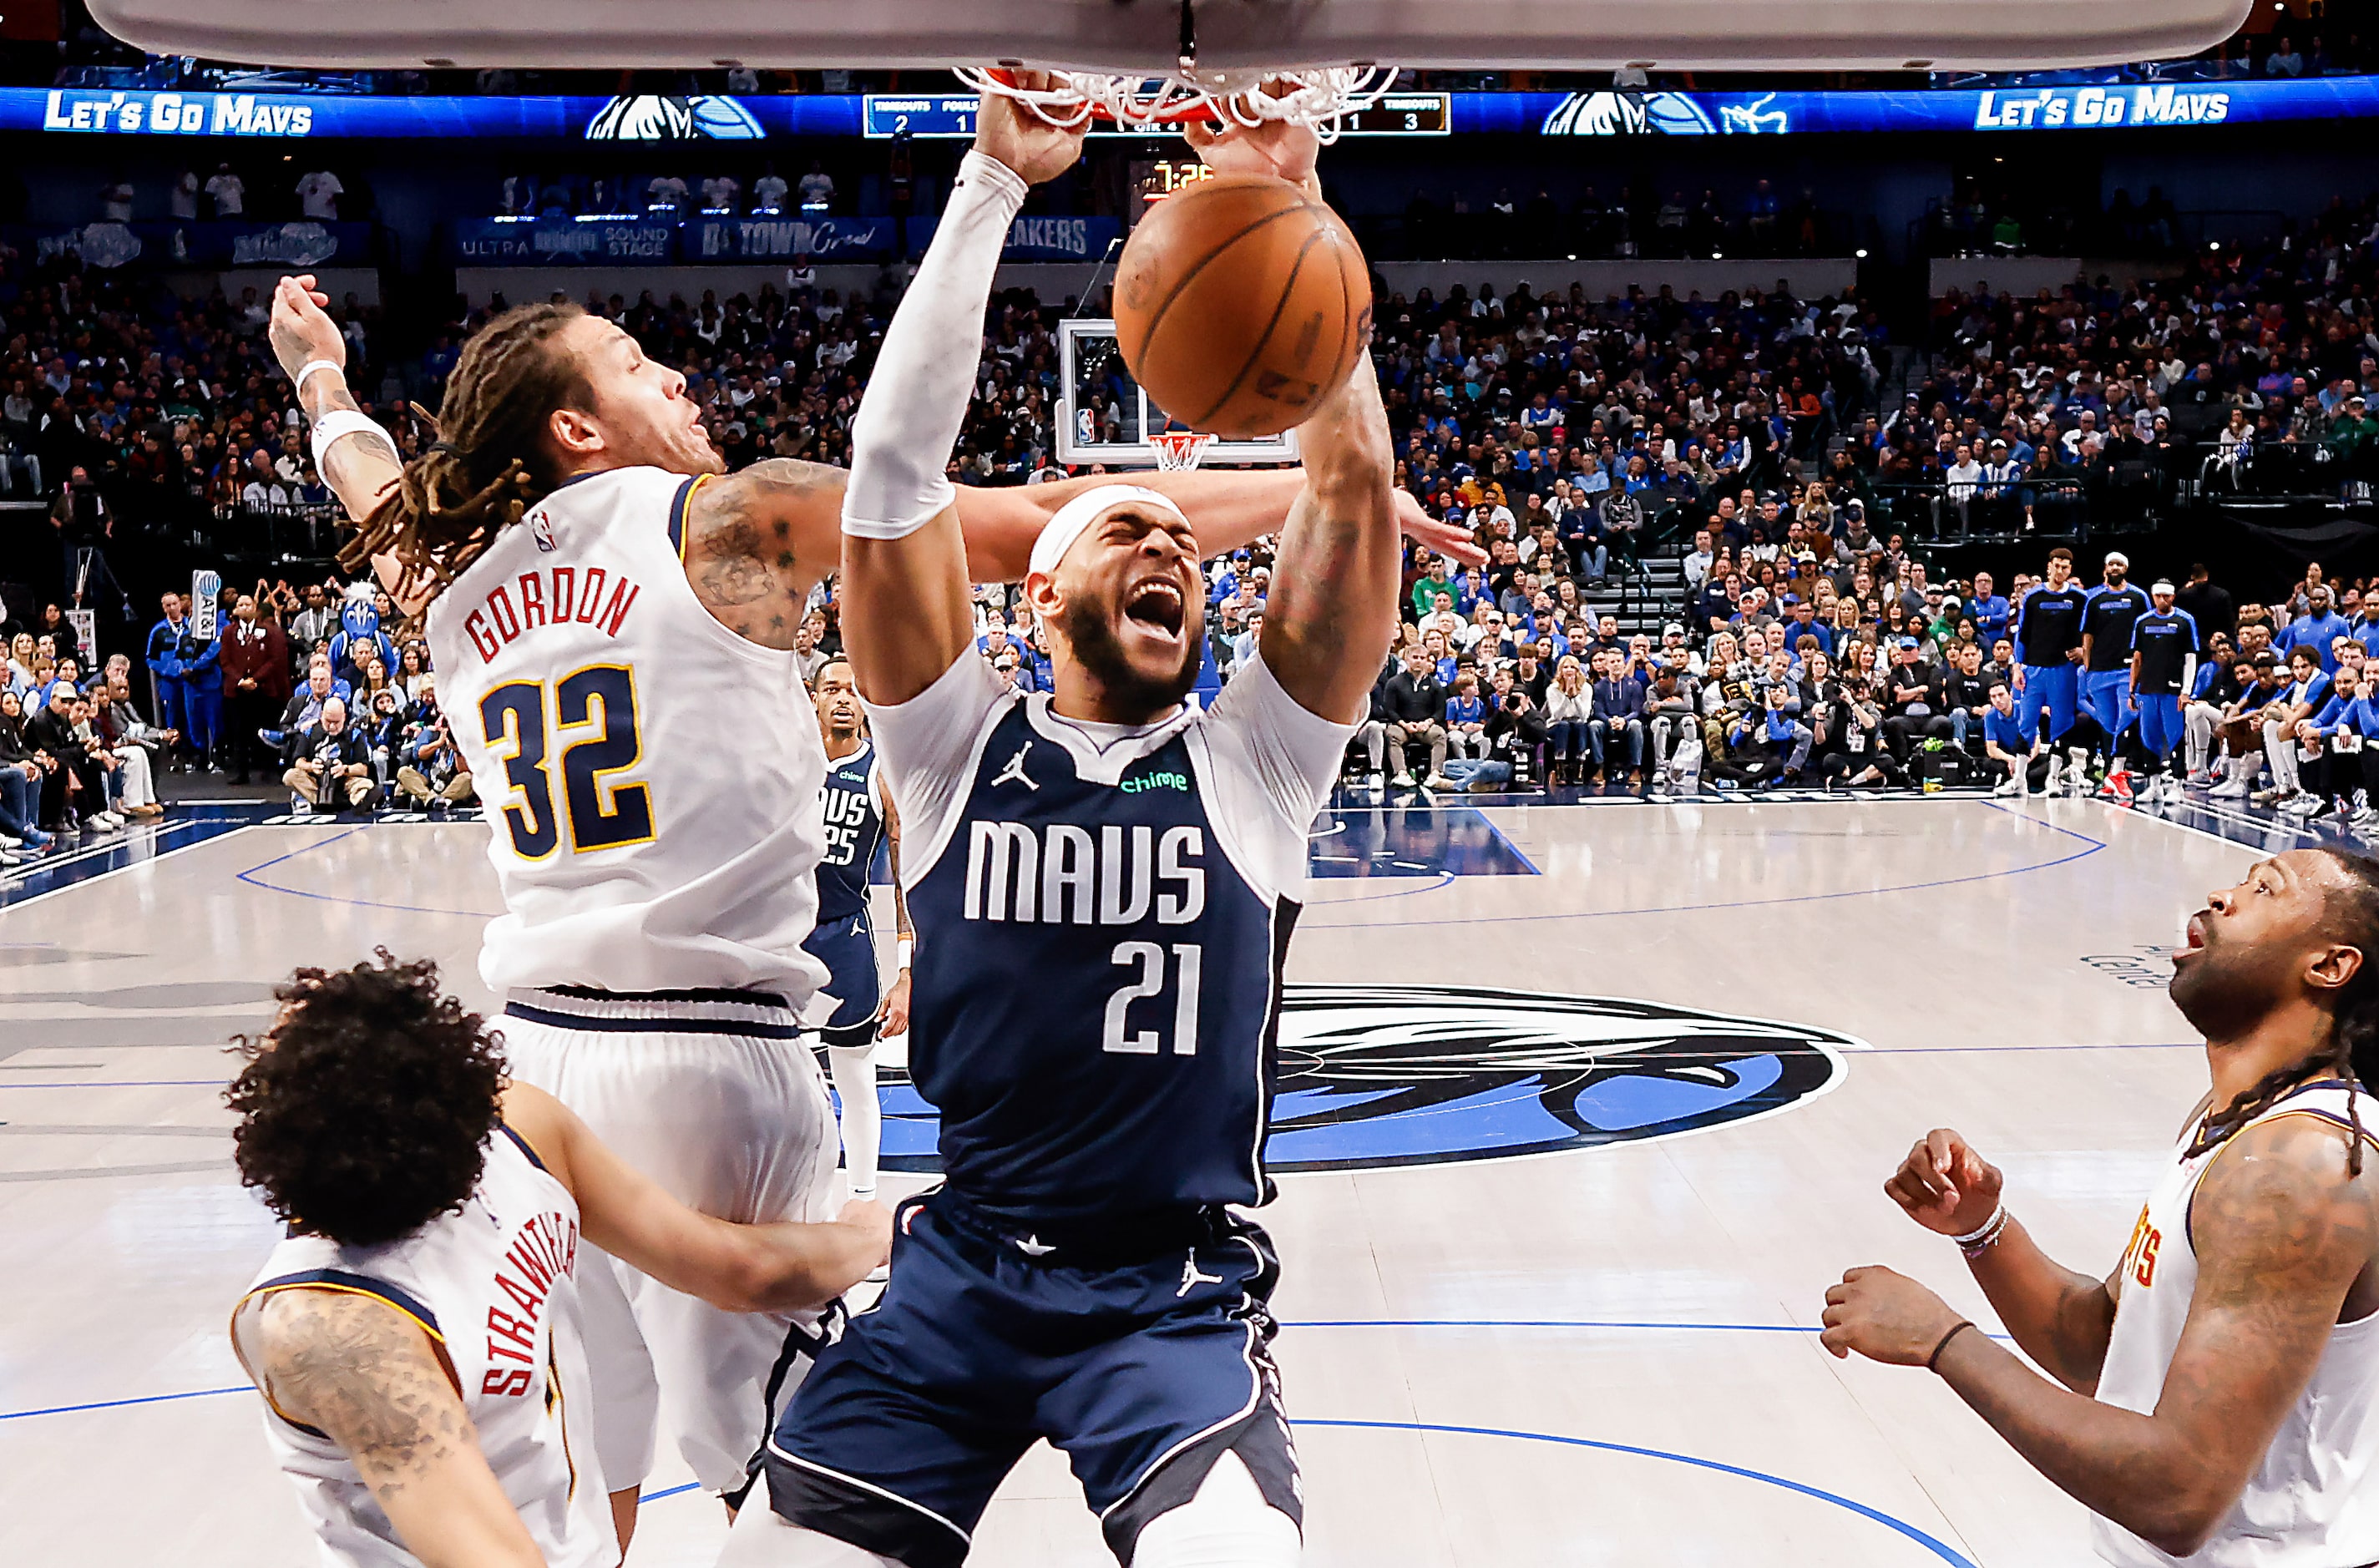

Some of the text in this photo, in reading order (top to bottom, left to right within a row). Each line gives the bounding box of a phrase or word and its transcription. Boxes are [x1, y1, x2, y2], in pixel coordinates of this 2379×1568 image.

[150, 93, 204, 133] GO
[210, 94, 312, 136] MAVS
[873, 100, 979, 112] TIMEOUTS FOULS
[1383, 99, 1441, 111] TIMEOUTS
[2073, 87, 2126, 128] GO
[2130, 84, 2230, 125] MAVS
[894, 114, 966, 134] 2 1
[1349, 113, 1418, 130] 1 3
[605, 226, 668, 242] SOUND
[1005, 219, 1086, 255] AKERS
[463, 240, 529, 255] ULTRA
[608, 241, 665, 256] STAGE
[464, 567, 640, 664] GORDON
[478, 662, 658, 862] 32
[839, 771, 866, 784] chime
[1120, 771, 1187, 795] chime
[819, 824, 859, 866] 25
[964, 820, 1206, 926] MAVS
[1101, 940, 1202, 1057] 21
